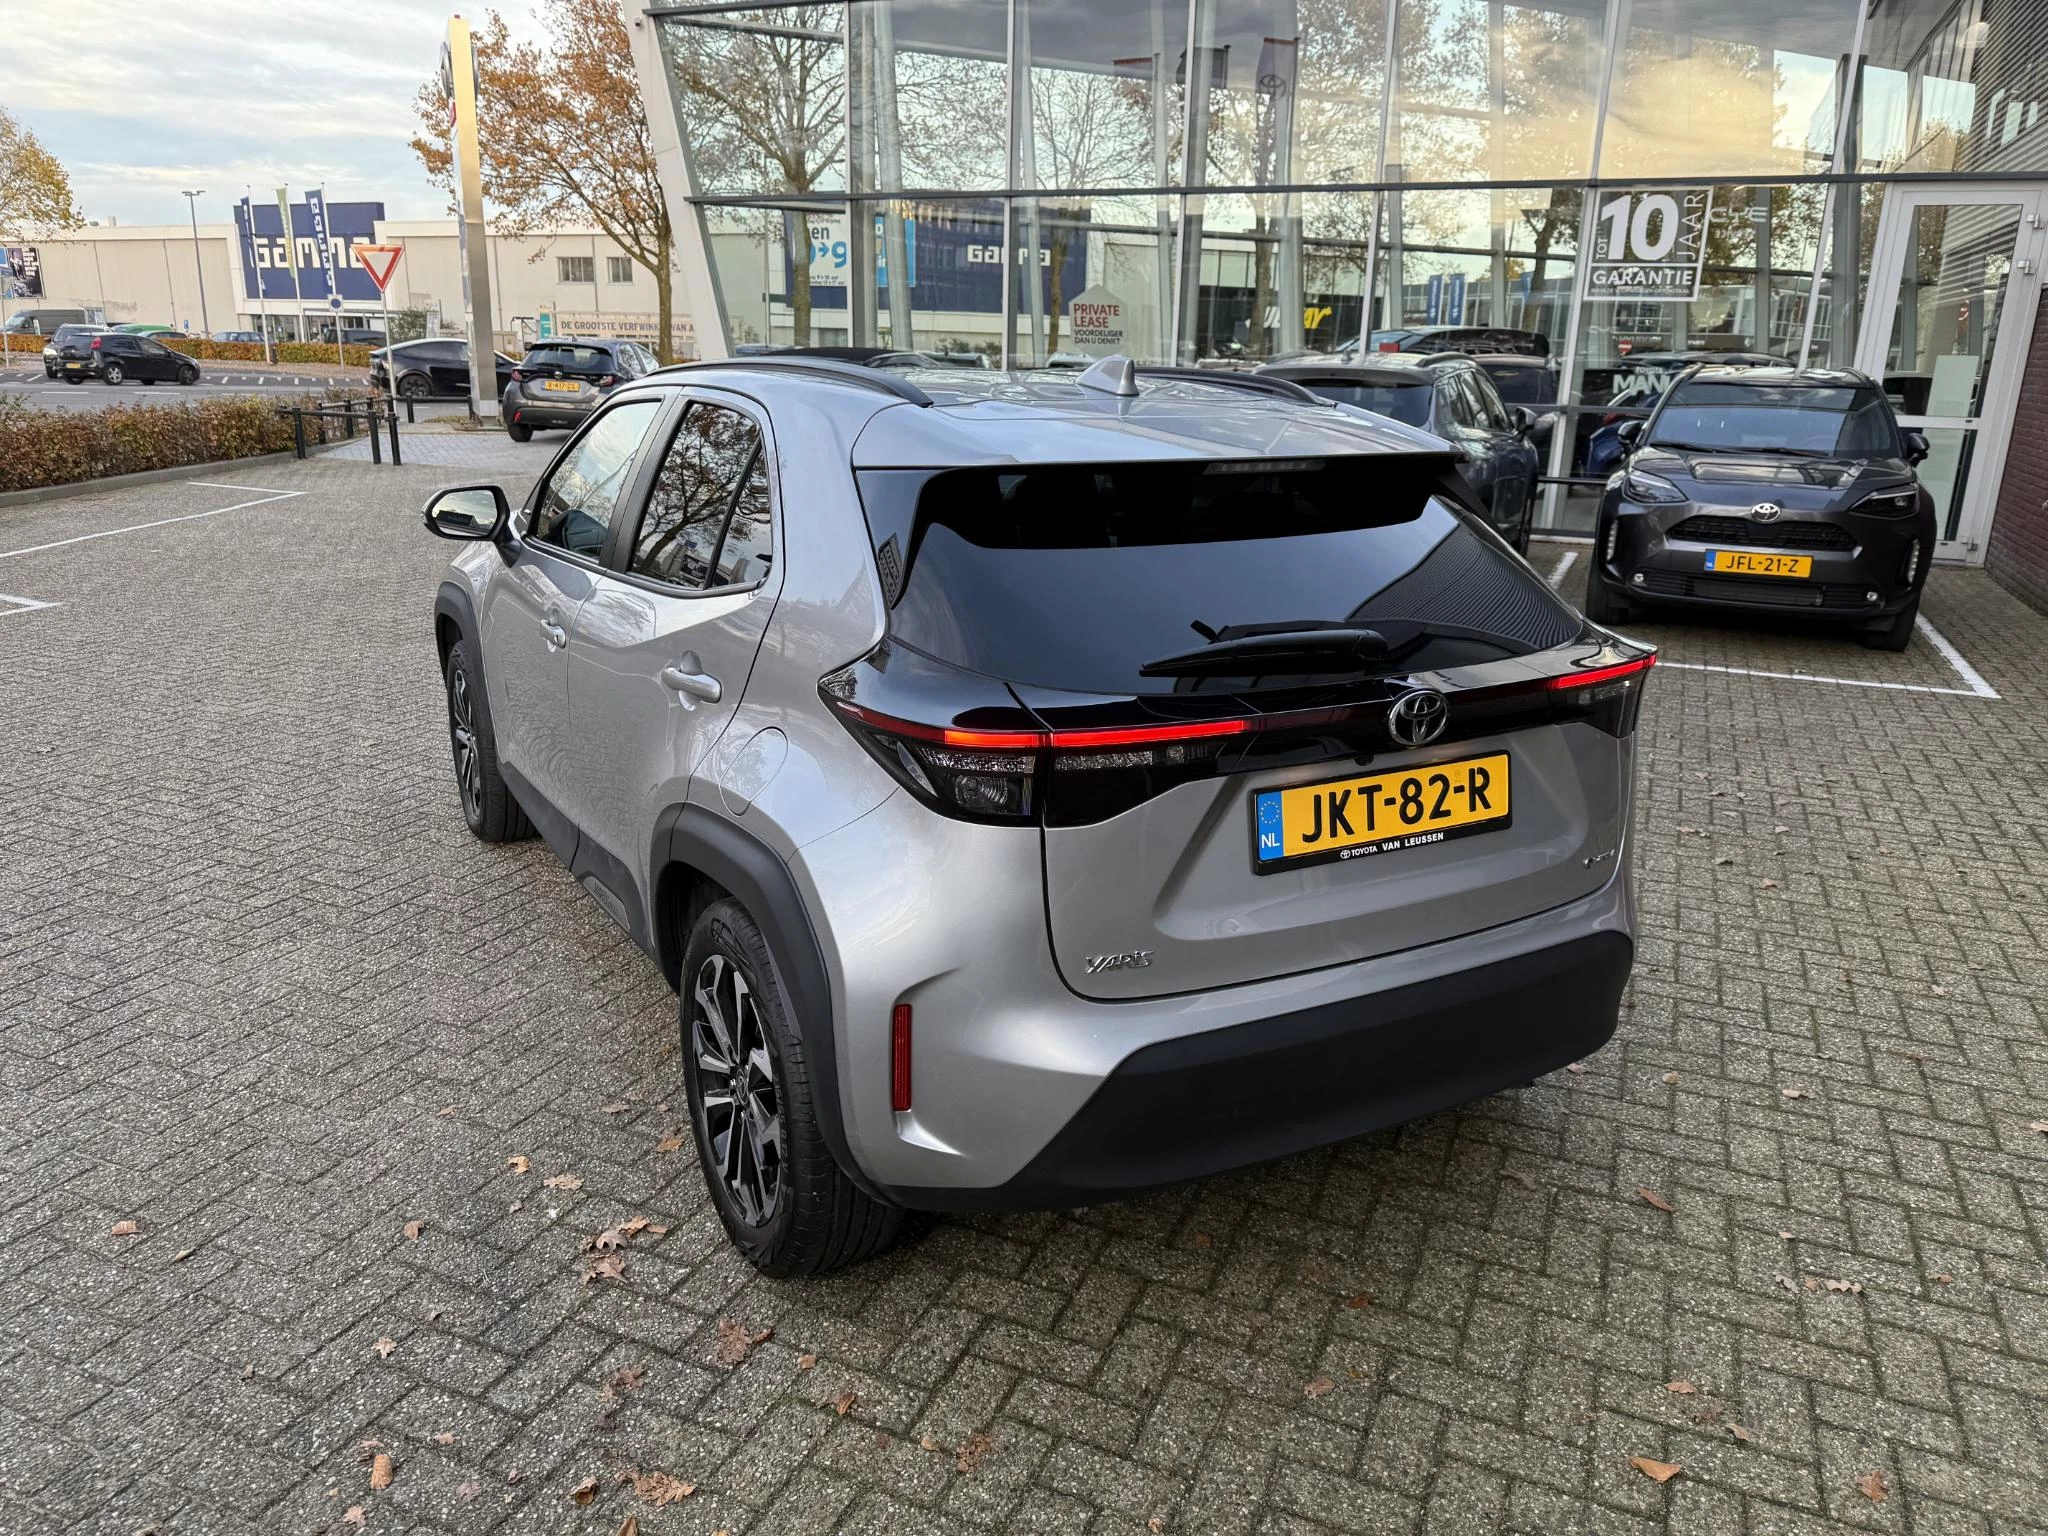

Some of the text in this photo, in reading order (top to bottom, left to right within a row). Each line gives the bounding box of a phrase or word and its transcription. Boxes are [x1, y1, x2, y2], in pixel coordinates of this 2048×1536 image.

[1600, 194, 1679, 261] 10
[1676, 194, 1705, 260] JAAR
[1596, 238, 1608, 259] TOT
[1592, 270, 1694, 286] GARANTIE
[1073, 303, 1120, 316] PRIVATE
[561, 321, 572, 330] DE
[574, 321, 617, 331] GROOTSTE
[1074, 316, 1109, 328] LEASE
[1074, 329, 1123, 338] VOORDELIGER
[1635, 366, 1664, 374] TOYOTA
[1726, 555, 1800, 573] JFL-21-Z
[1302, 766, 1492, 843] JKT-82-R
[1261, 833, 1280, 849] NL
[1351, 832, 1444, 857] TOYOTA VAN LEUSSEN
